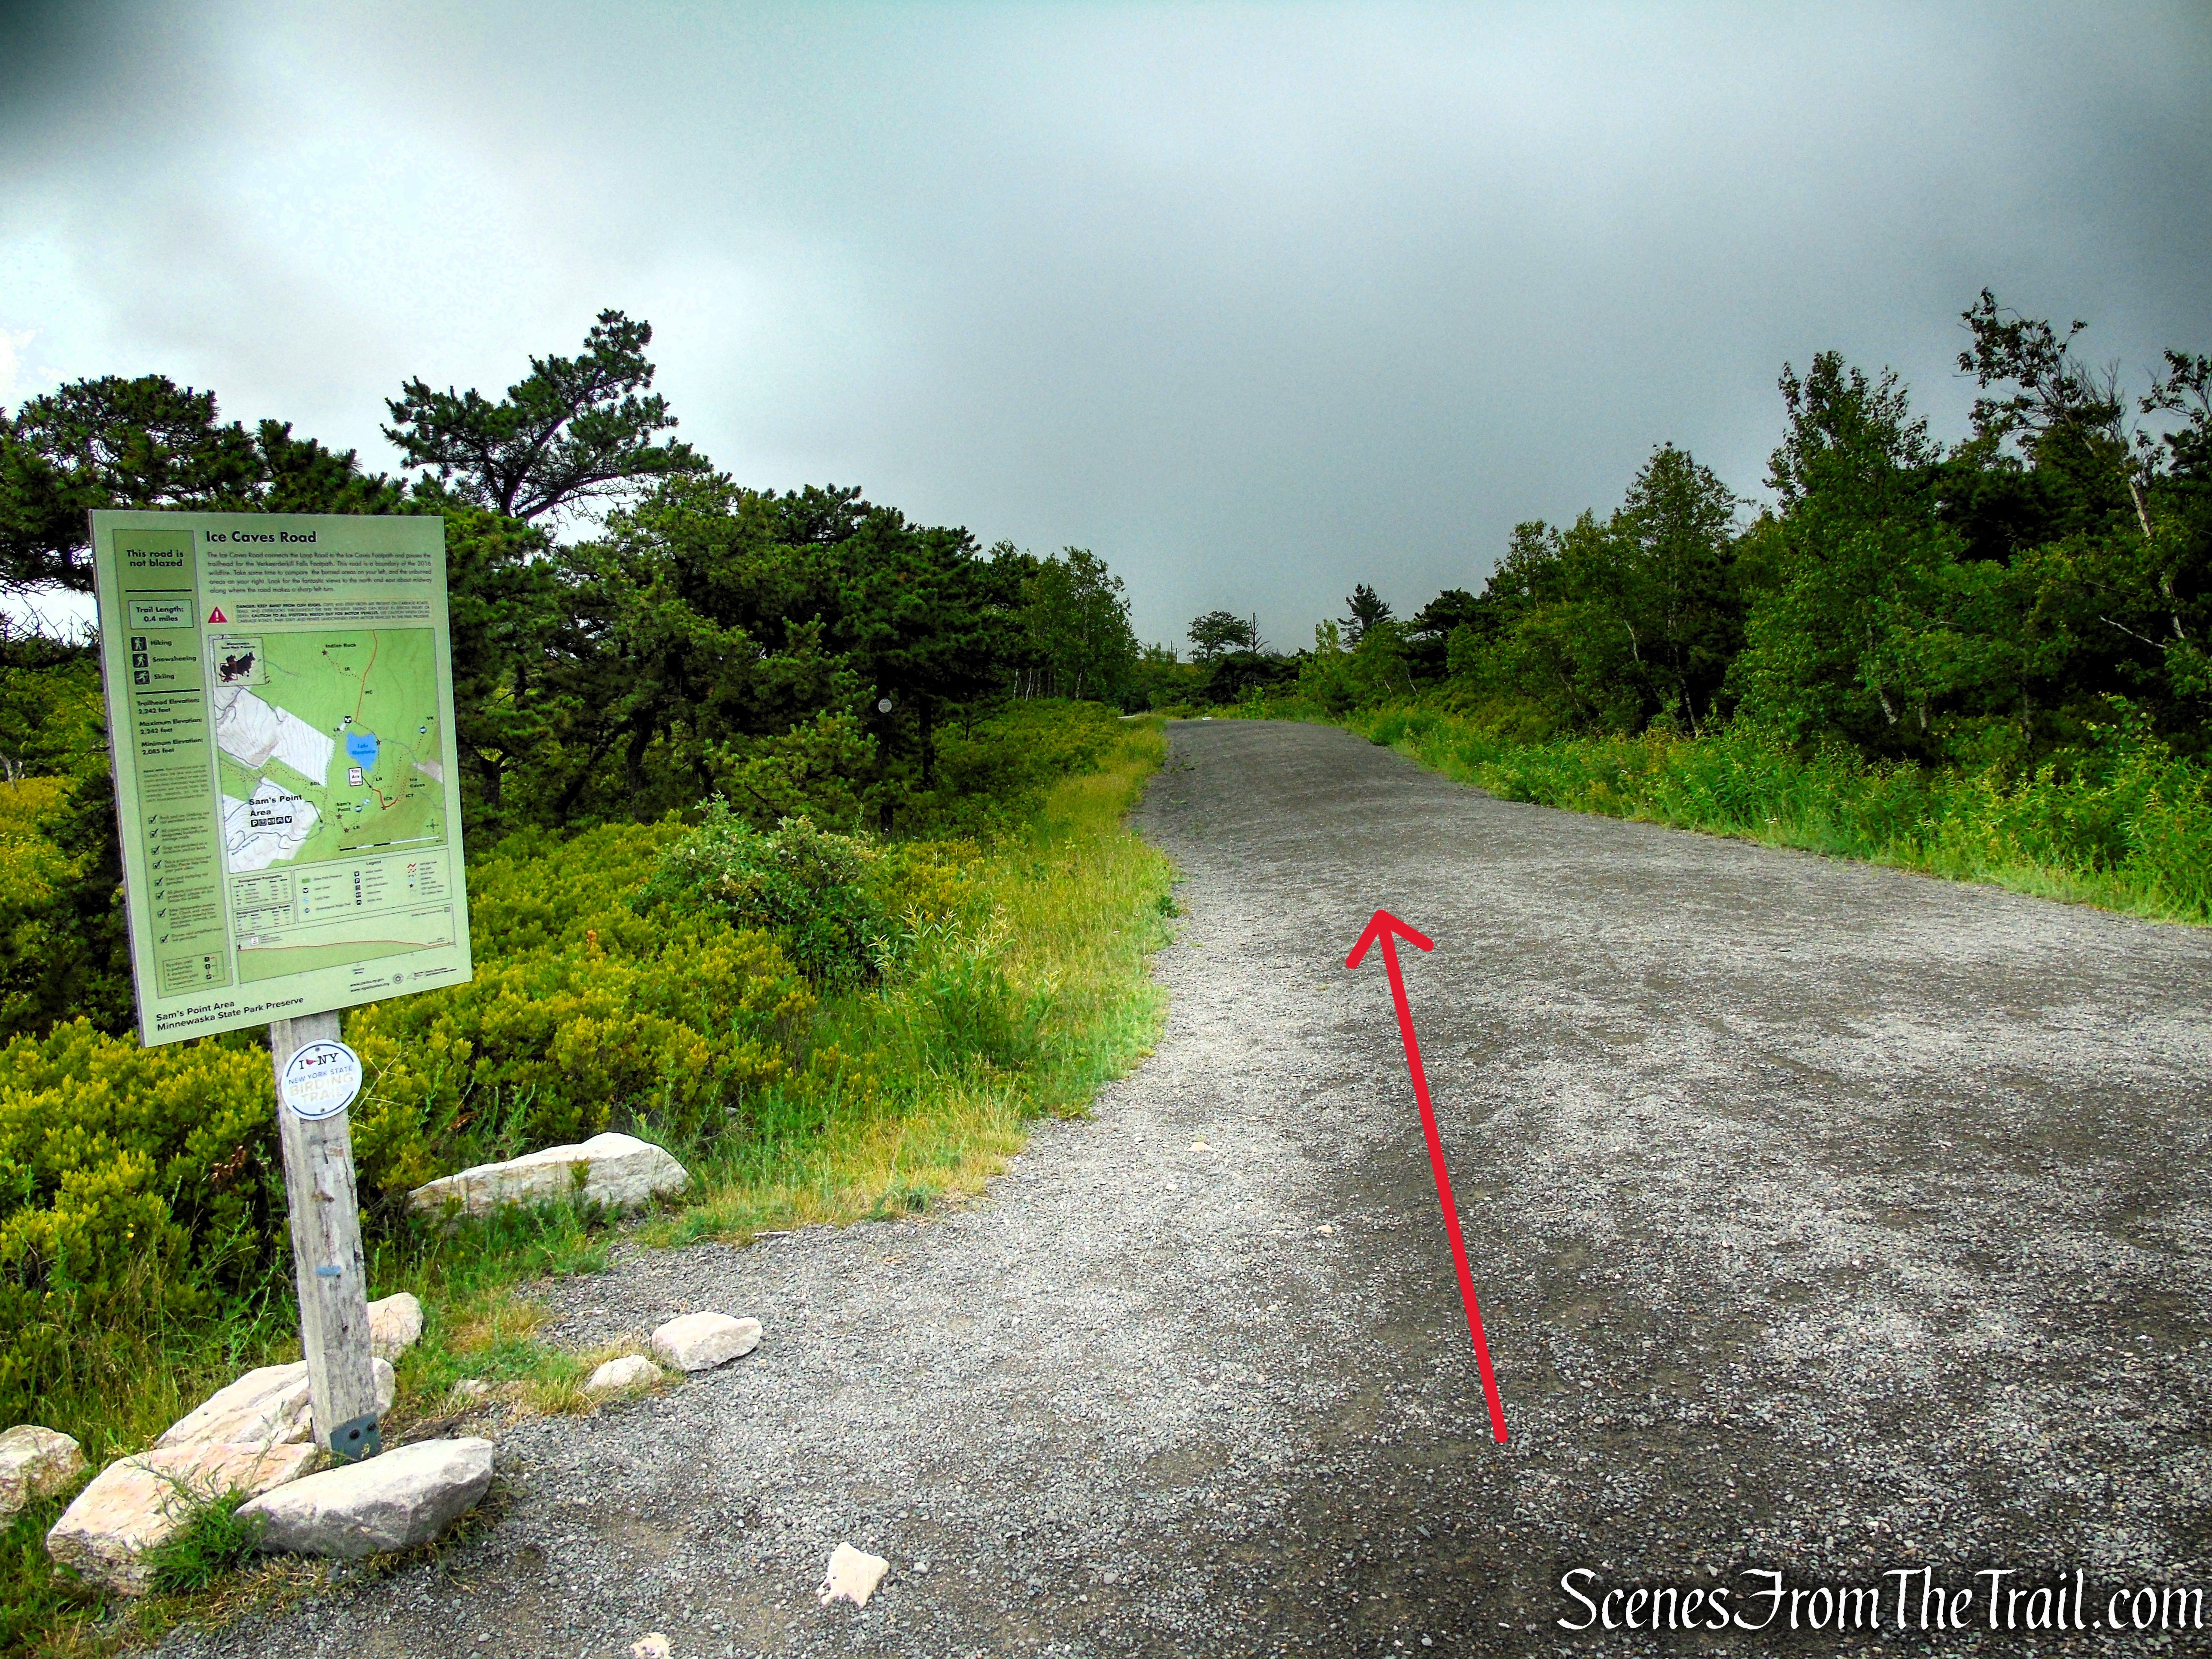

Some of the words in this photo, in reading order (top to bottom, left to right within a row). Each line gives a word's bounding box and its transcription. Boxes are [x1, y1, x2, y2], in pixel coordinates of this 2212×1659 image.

[206, 531, 227, 542] Ice
[232, 530, 275, 542] Caves
[280, 531, 316, 542] Road
[249, 797, 276, 805] Sam's
[156, 1010, 184, 1021] Sam's
[187, 1005, 211, 1015] Point
[214, 1001, 235, 1010] Area
[157, 1014, 216, 1031] Minnewaska
[218, 1009, 241, 1019] State
[244, 1005, 264, 1014] Park
[266, 997, 304, 1010] Preserve
[299, 1060, 304, 1070] I
[317, 1052, 339, 1065] NY
[289, 1076, 305, 1085] NEW
[307, 1071, 327, 1079] YORK
[331, 1065, 353, 1075] STATE
[290, 1073, 353, 1096] BIRDING
[301, 1087, 344, 1104] TRAIL
